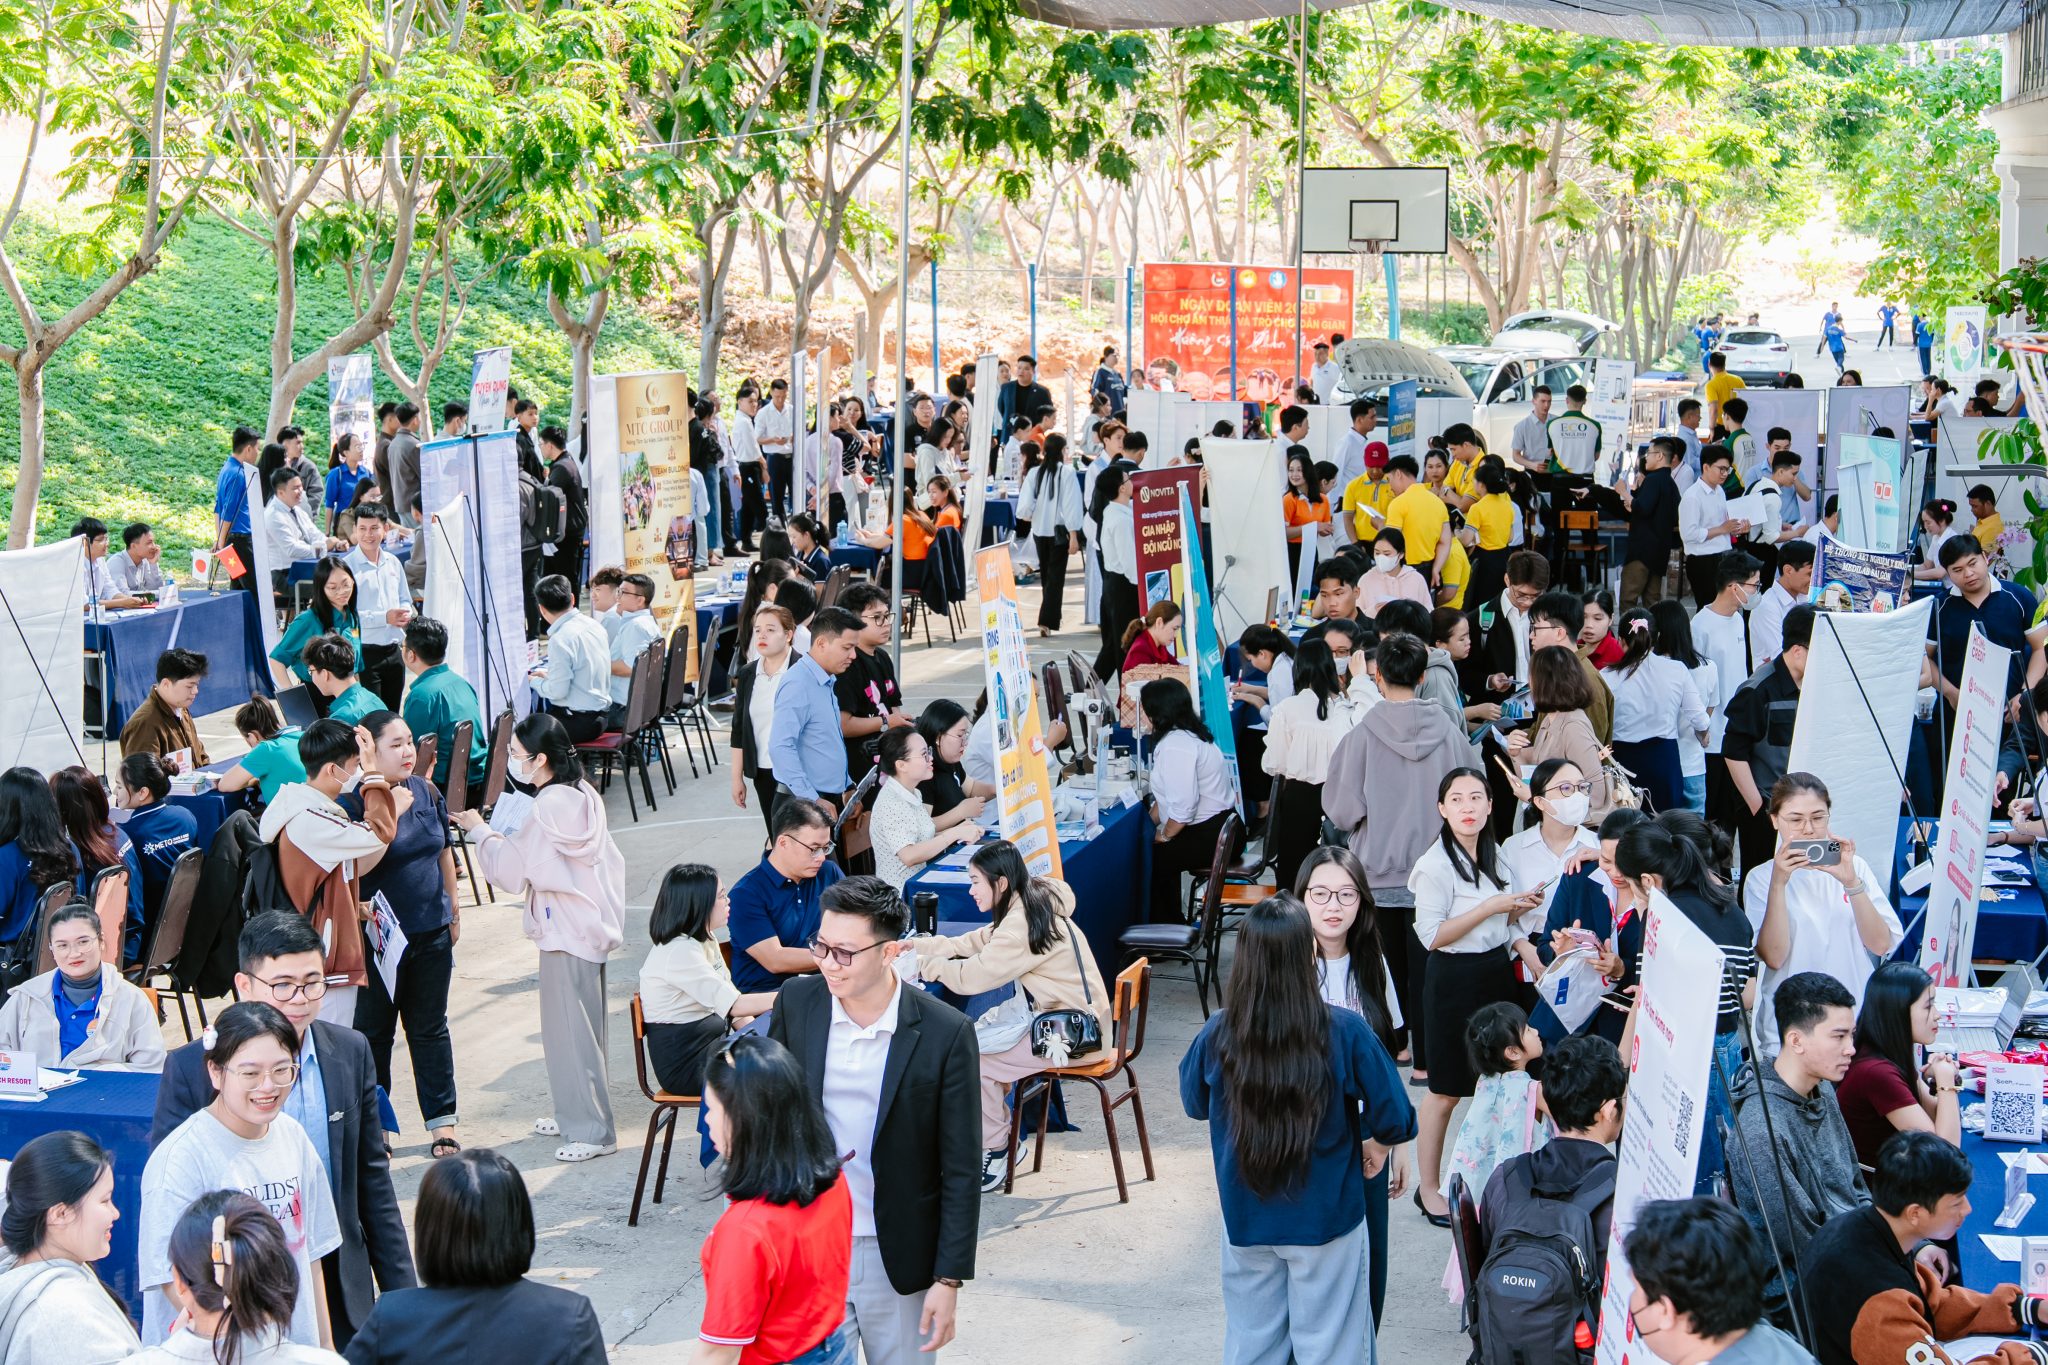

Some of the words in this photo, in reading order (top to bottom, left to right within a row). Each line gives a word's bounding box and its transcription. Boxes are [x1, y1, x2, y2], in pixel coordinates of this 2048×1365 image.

[649, 419, 683, 434] GROUP
[1561, 422, 1588, 432] ECO
[1150, 487, 1175, 498] NOVITA
[1142, 524, 1156, 537] GIA
[1971, 647, 1986, 664] CREDIT
[154, 838, 173, 850] METO
[7, 1077, 31, 1085] RESORT
[1502, 1274, 1537, 1288] ROKIN
